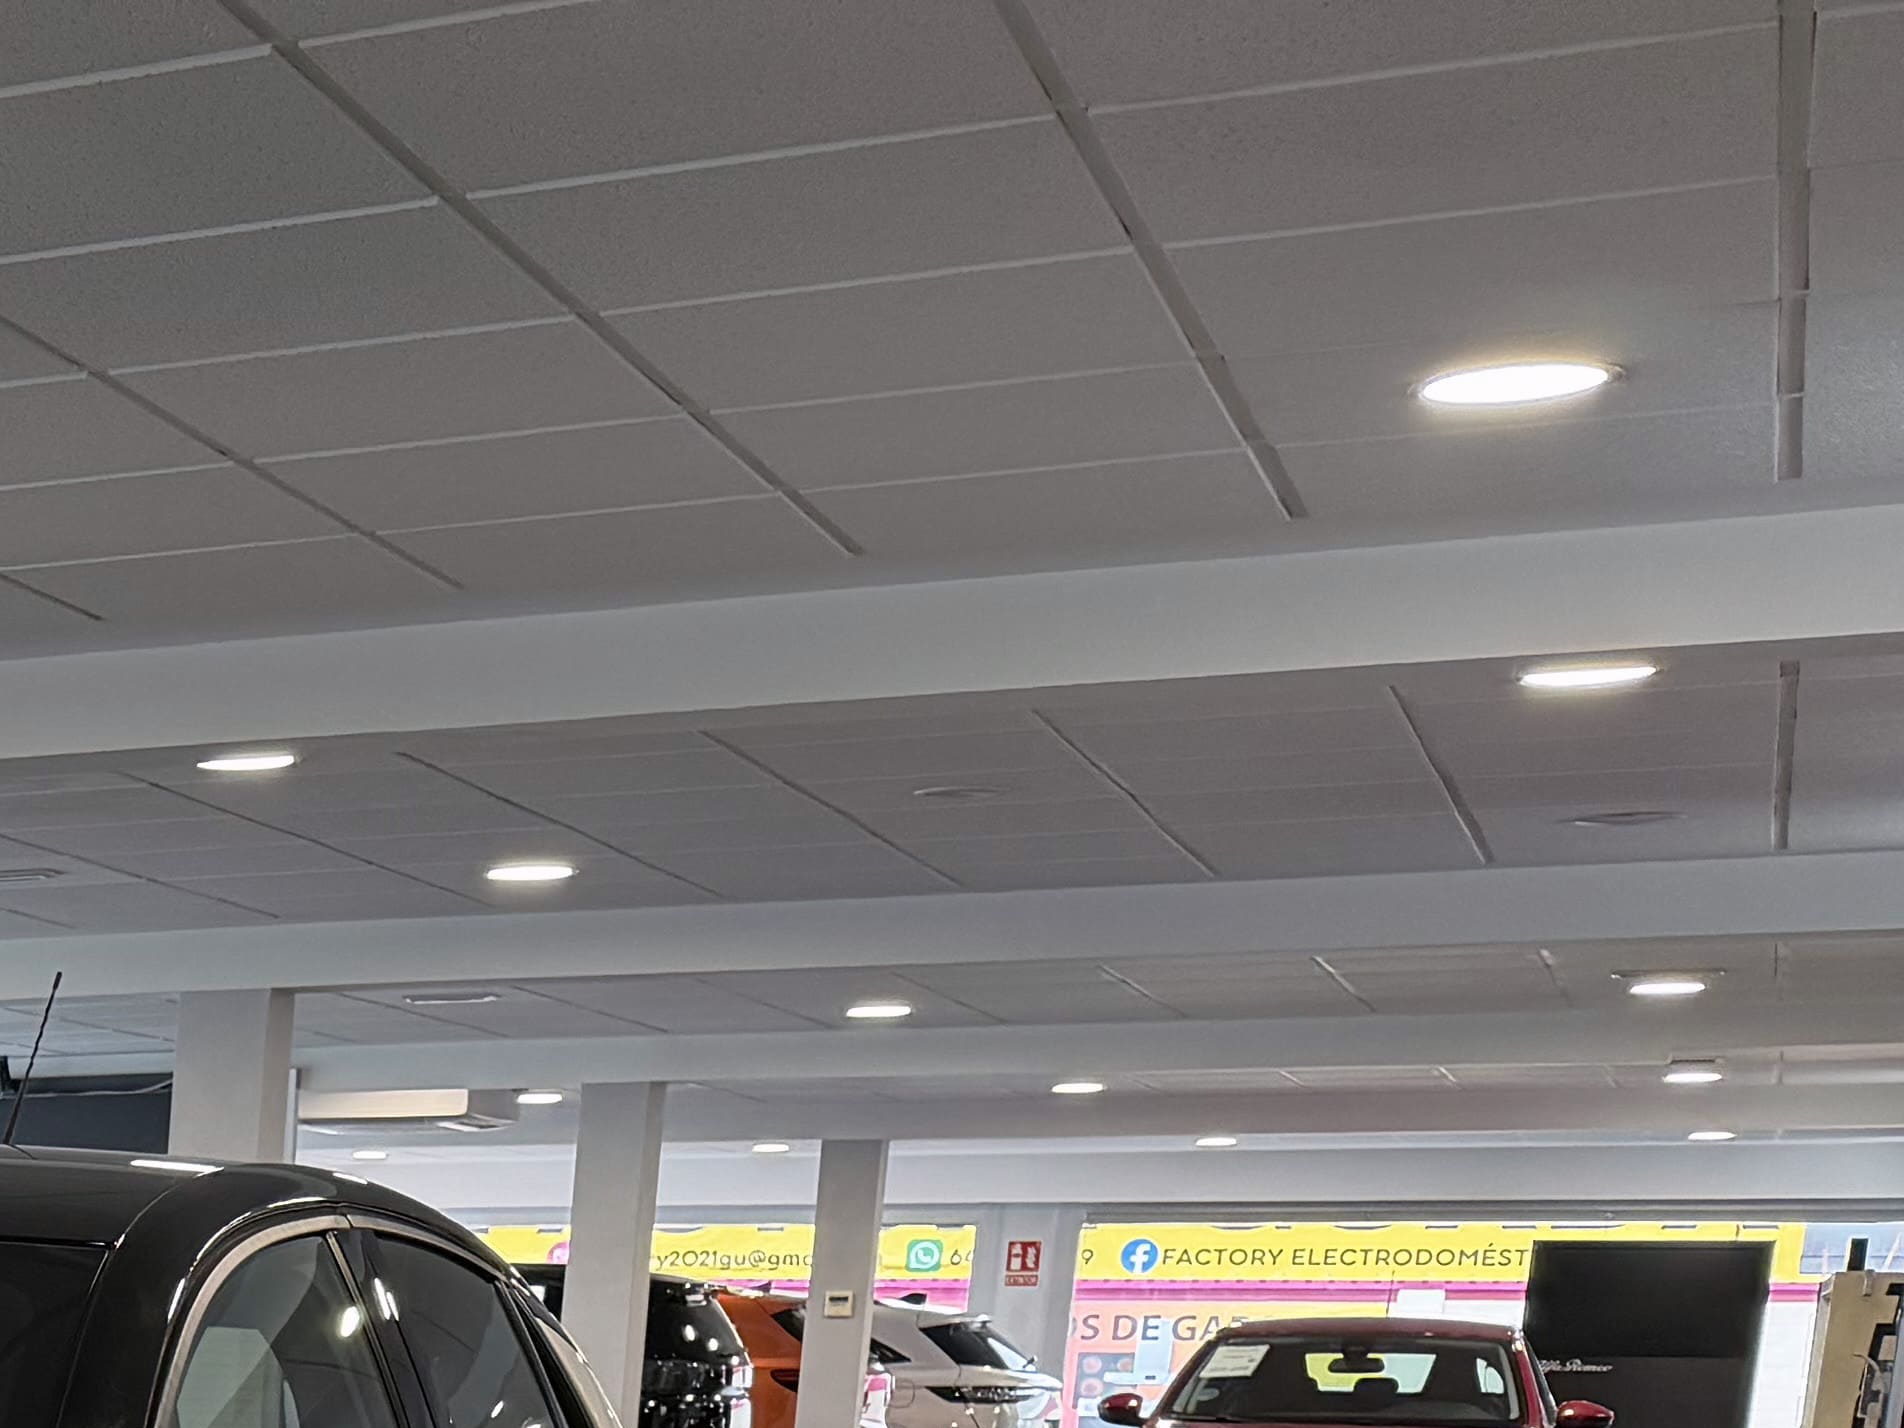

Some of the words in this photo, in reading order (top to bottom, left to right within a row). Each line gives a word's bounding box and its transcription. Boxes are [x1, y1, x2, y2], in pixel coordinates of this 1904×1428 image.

[1162, 1247, 1285, 1266] FACTORY
[1291, 1242, 1530, 1267] ELECTRODOMÉST
[1112, 1315, 1162, 1341] DE
[1171, 1315, 1249, 1341] GA
